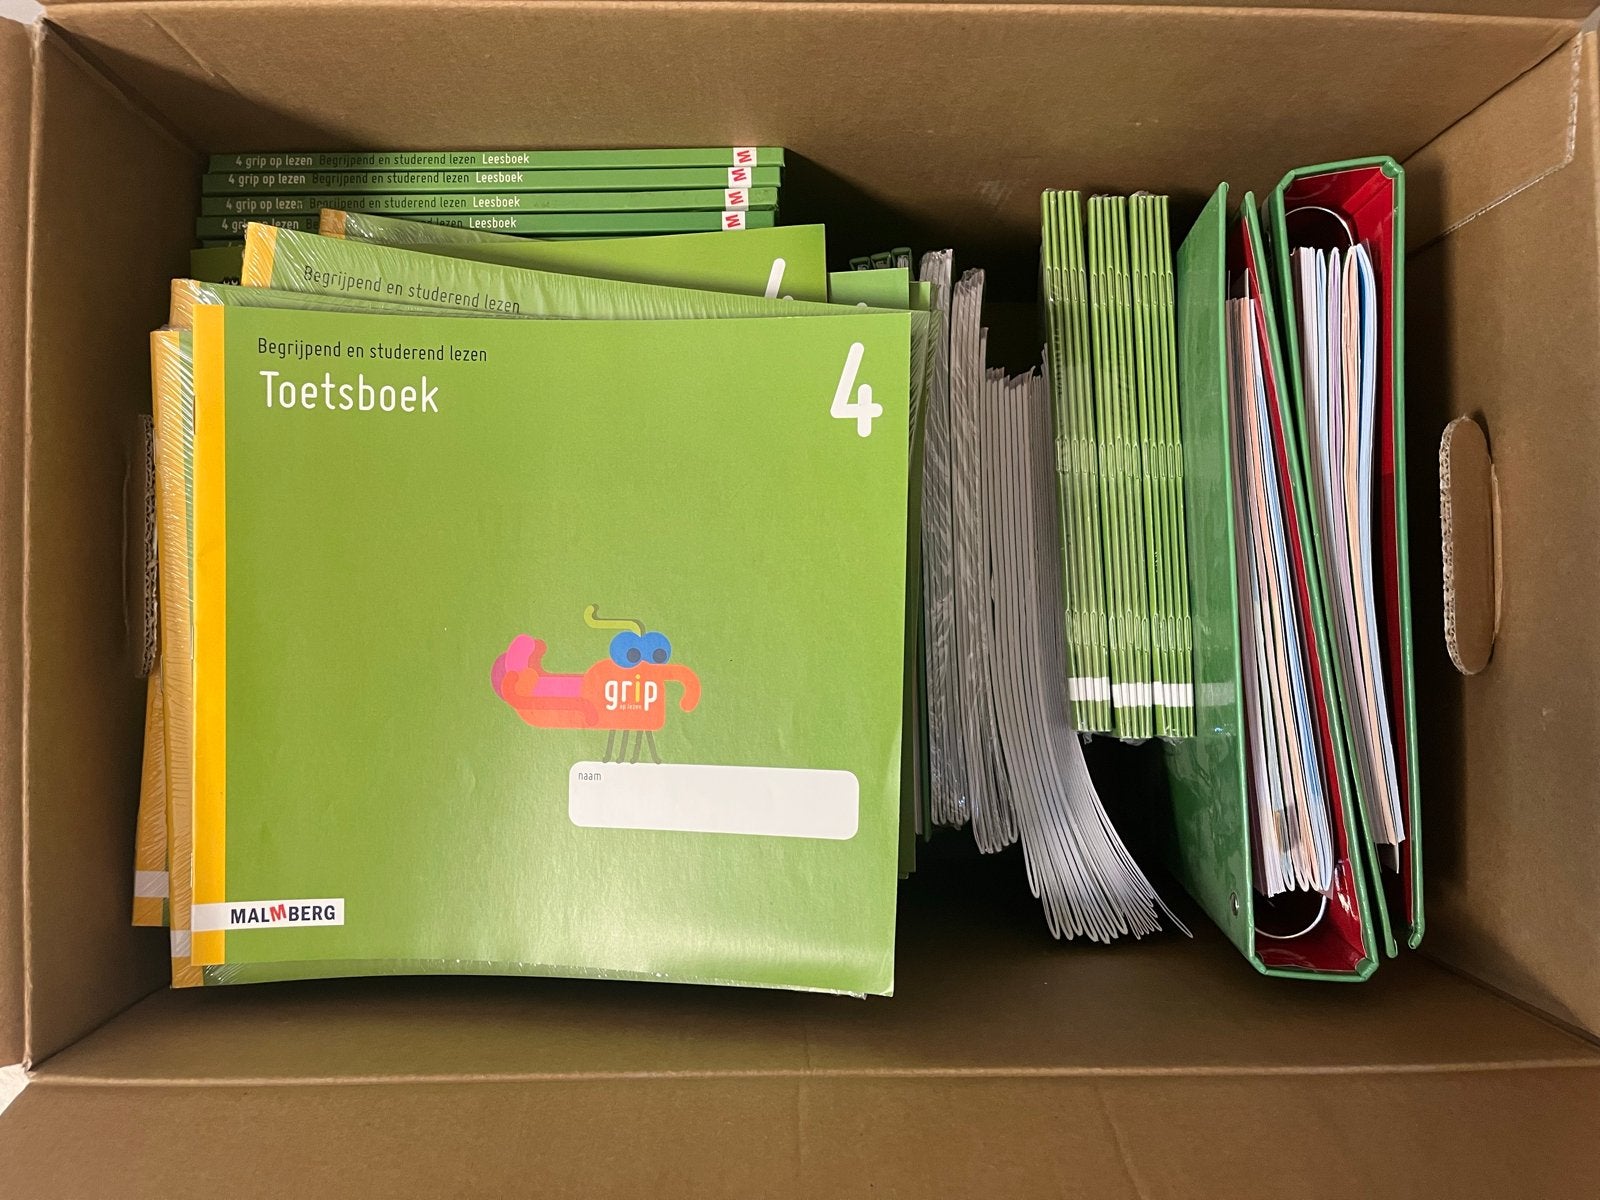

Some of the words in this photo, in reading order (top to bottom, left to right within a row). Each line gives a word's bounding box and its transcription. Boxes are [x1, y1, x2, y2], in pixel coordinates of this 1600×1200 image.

[235, 156, 242, 166] 4
[245, 155, 266, 169] grip
[269, 156, 282, 169] op
[285, 154, 313, 166] lezen
[319, 154, 375, 168] Begrijpend
[378, 156, 391, 165] en
[394, 153, 446, 165] studerend
[449, 153, 476, 165] lezen
[482, 153, 530, 165] Leesboek
[228, 174, 235, 184] 4
[238, 173, 259, 188] grip
[262, 175, 275, 187] op
[278, 173, 306, 184] lezen
[312, 172, 368, 187] Begrijpend
[371, 175, 384, 184] en
[387, 172, 439, 184] studerend
[442, 171, 470, 183] lezen
[475, 171, 523, 183] Leesboek
[225, 199, 232, 210] 4
[235, 198, 257, 213] grip
[260, 200, 273, 213] op
[275, 197, 303, 210] lezen
[368, 199, 381, 209] en
[384, 197, 437, 208] studerend
[440, 197, 467, 208] lezen
[473, 195, 520, 208] Leesboek
[221, 218, 228, 230] 4
[469, 216, 517, 228] Leesboek
[303, 265, 382, 291] Begrijpend
[386, 282, 403, 296] en
[407, 283, 479, 308] studerend
[484, 294, 520, 314] lezen
[258, 337, 341, 360] Begrijpend
[347, 344, 364, 358] en
[369, 343, 444, 361] studerend
[450, 345, 487, 362] lezen
[259, 370, 439, 413] Toetsboek
[830, 342, 884, 438] 4
[604, 673, 658, 712] grip
[577, 771, 602, 781] naam
[230, 903, 336, 924] MALMBERG
